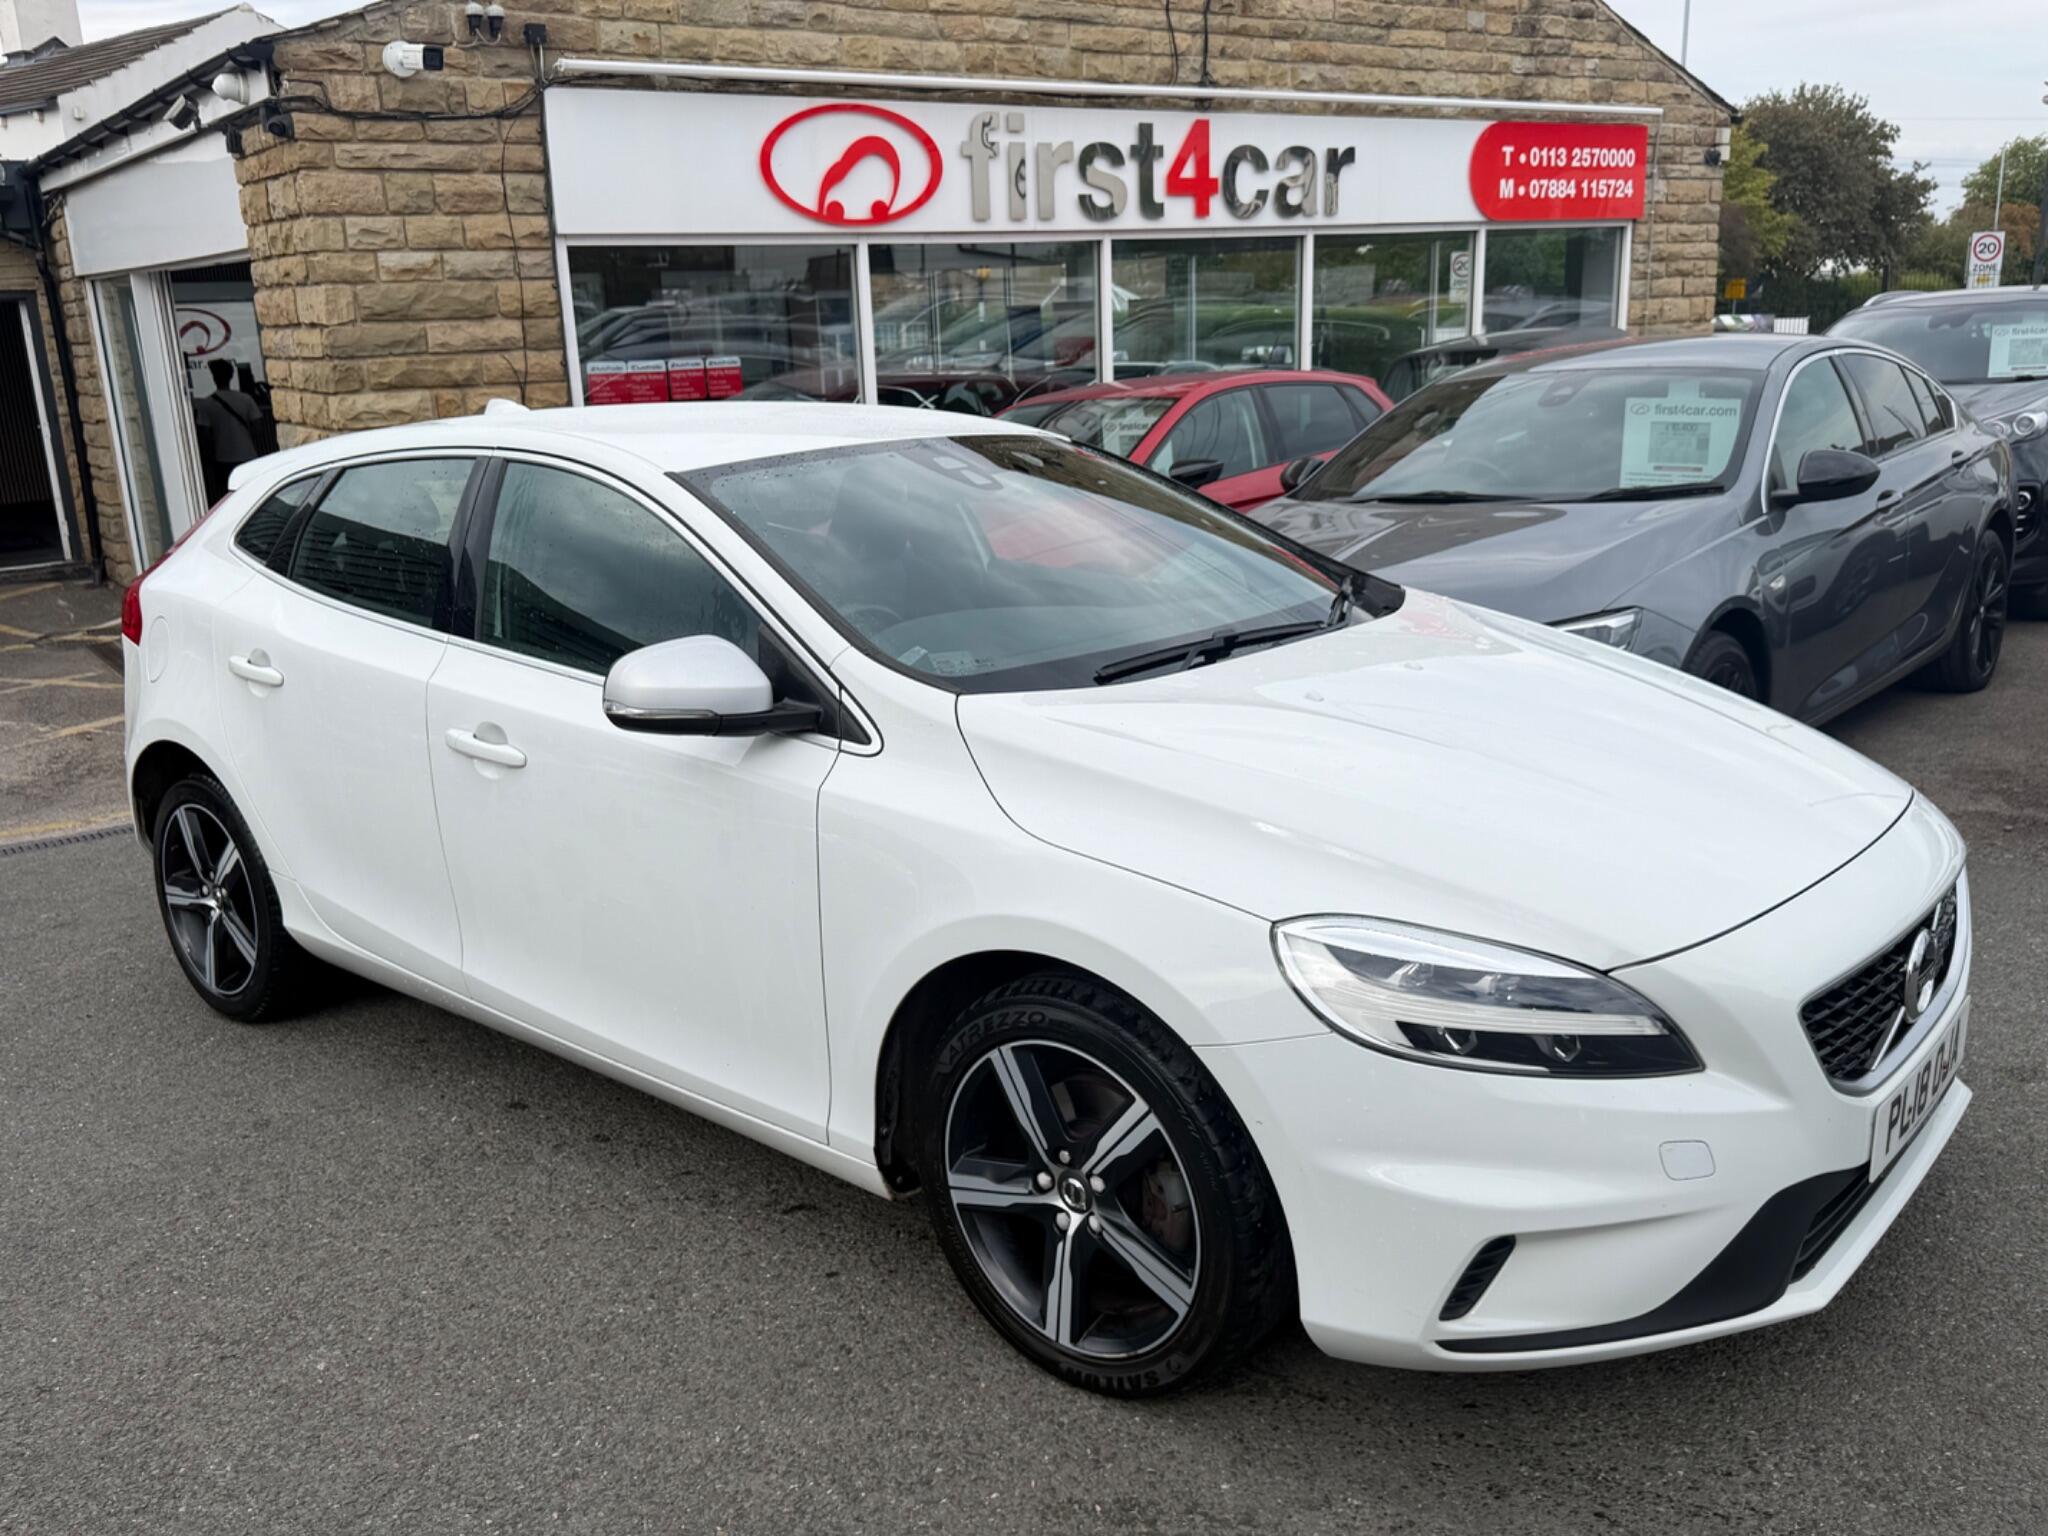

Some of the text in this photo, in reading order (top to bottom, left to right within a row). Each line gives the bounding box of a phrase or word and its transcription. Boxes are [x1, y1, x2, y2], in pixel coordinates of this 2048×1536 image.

[961, 111, 1356, 222] first4car
[1501, 145, 1636, 168] T 0113 2570000
[1499, 178, 1634, 199] M 07884 115724
[1978, 242, 1997, 254] 20
[1973, 263, 1997, 272] ZONE
[1654, 403, 1737, 416] first4car.com
[1886, 1060, 1931, 1156] PL18
